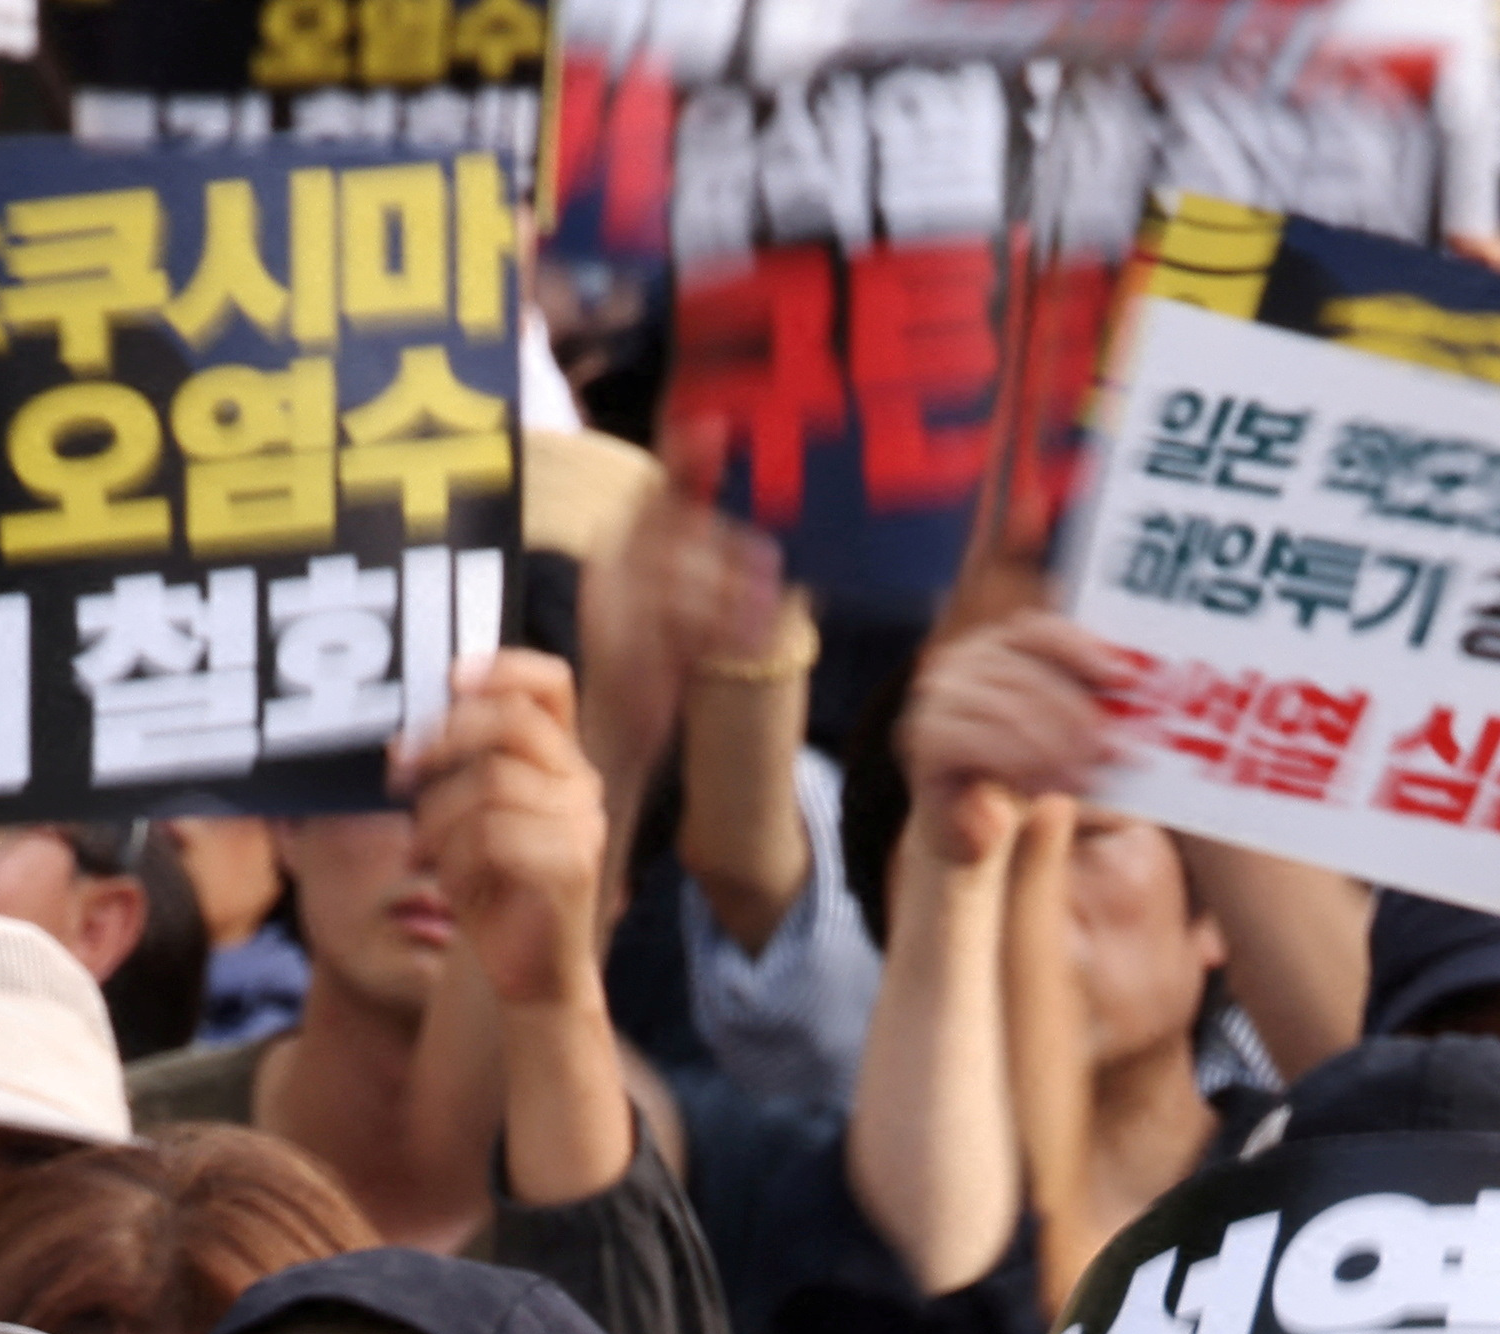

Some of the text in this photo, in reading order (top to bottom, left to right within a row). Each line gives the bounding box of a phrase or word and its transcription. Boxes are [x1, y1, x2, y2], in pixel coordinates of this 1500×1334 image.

[1143, 390, 1500, 535] 일본 핵오
[1117, 510, 1450, 650] 해양투기
